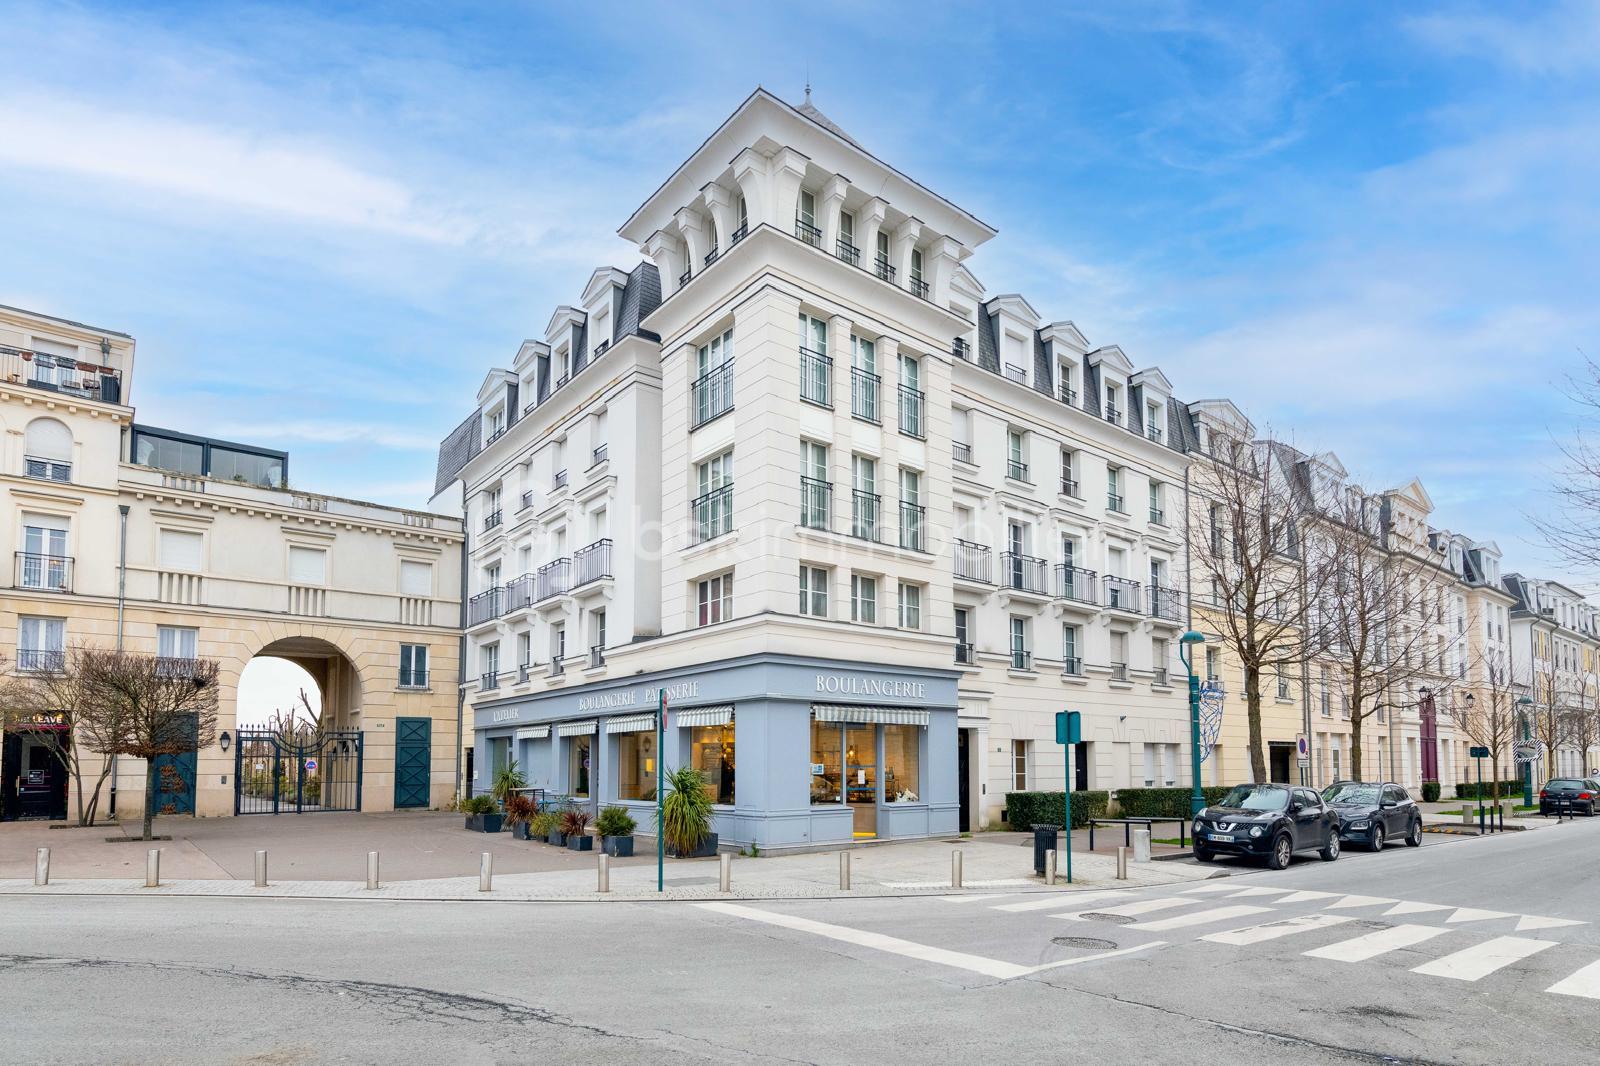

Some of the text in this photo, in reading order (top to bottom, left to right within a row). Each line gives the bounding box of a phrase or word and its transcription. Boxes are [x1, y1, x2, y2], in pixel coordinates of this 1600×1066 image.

[579, 681, 699, 711] BOULANGERIE PÂTSSERIE
[816, 675, 925, 698] BOULANGERIE
